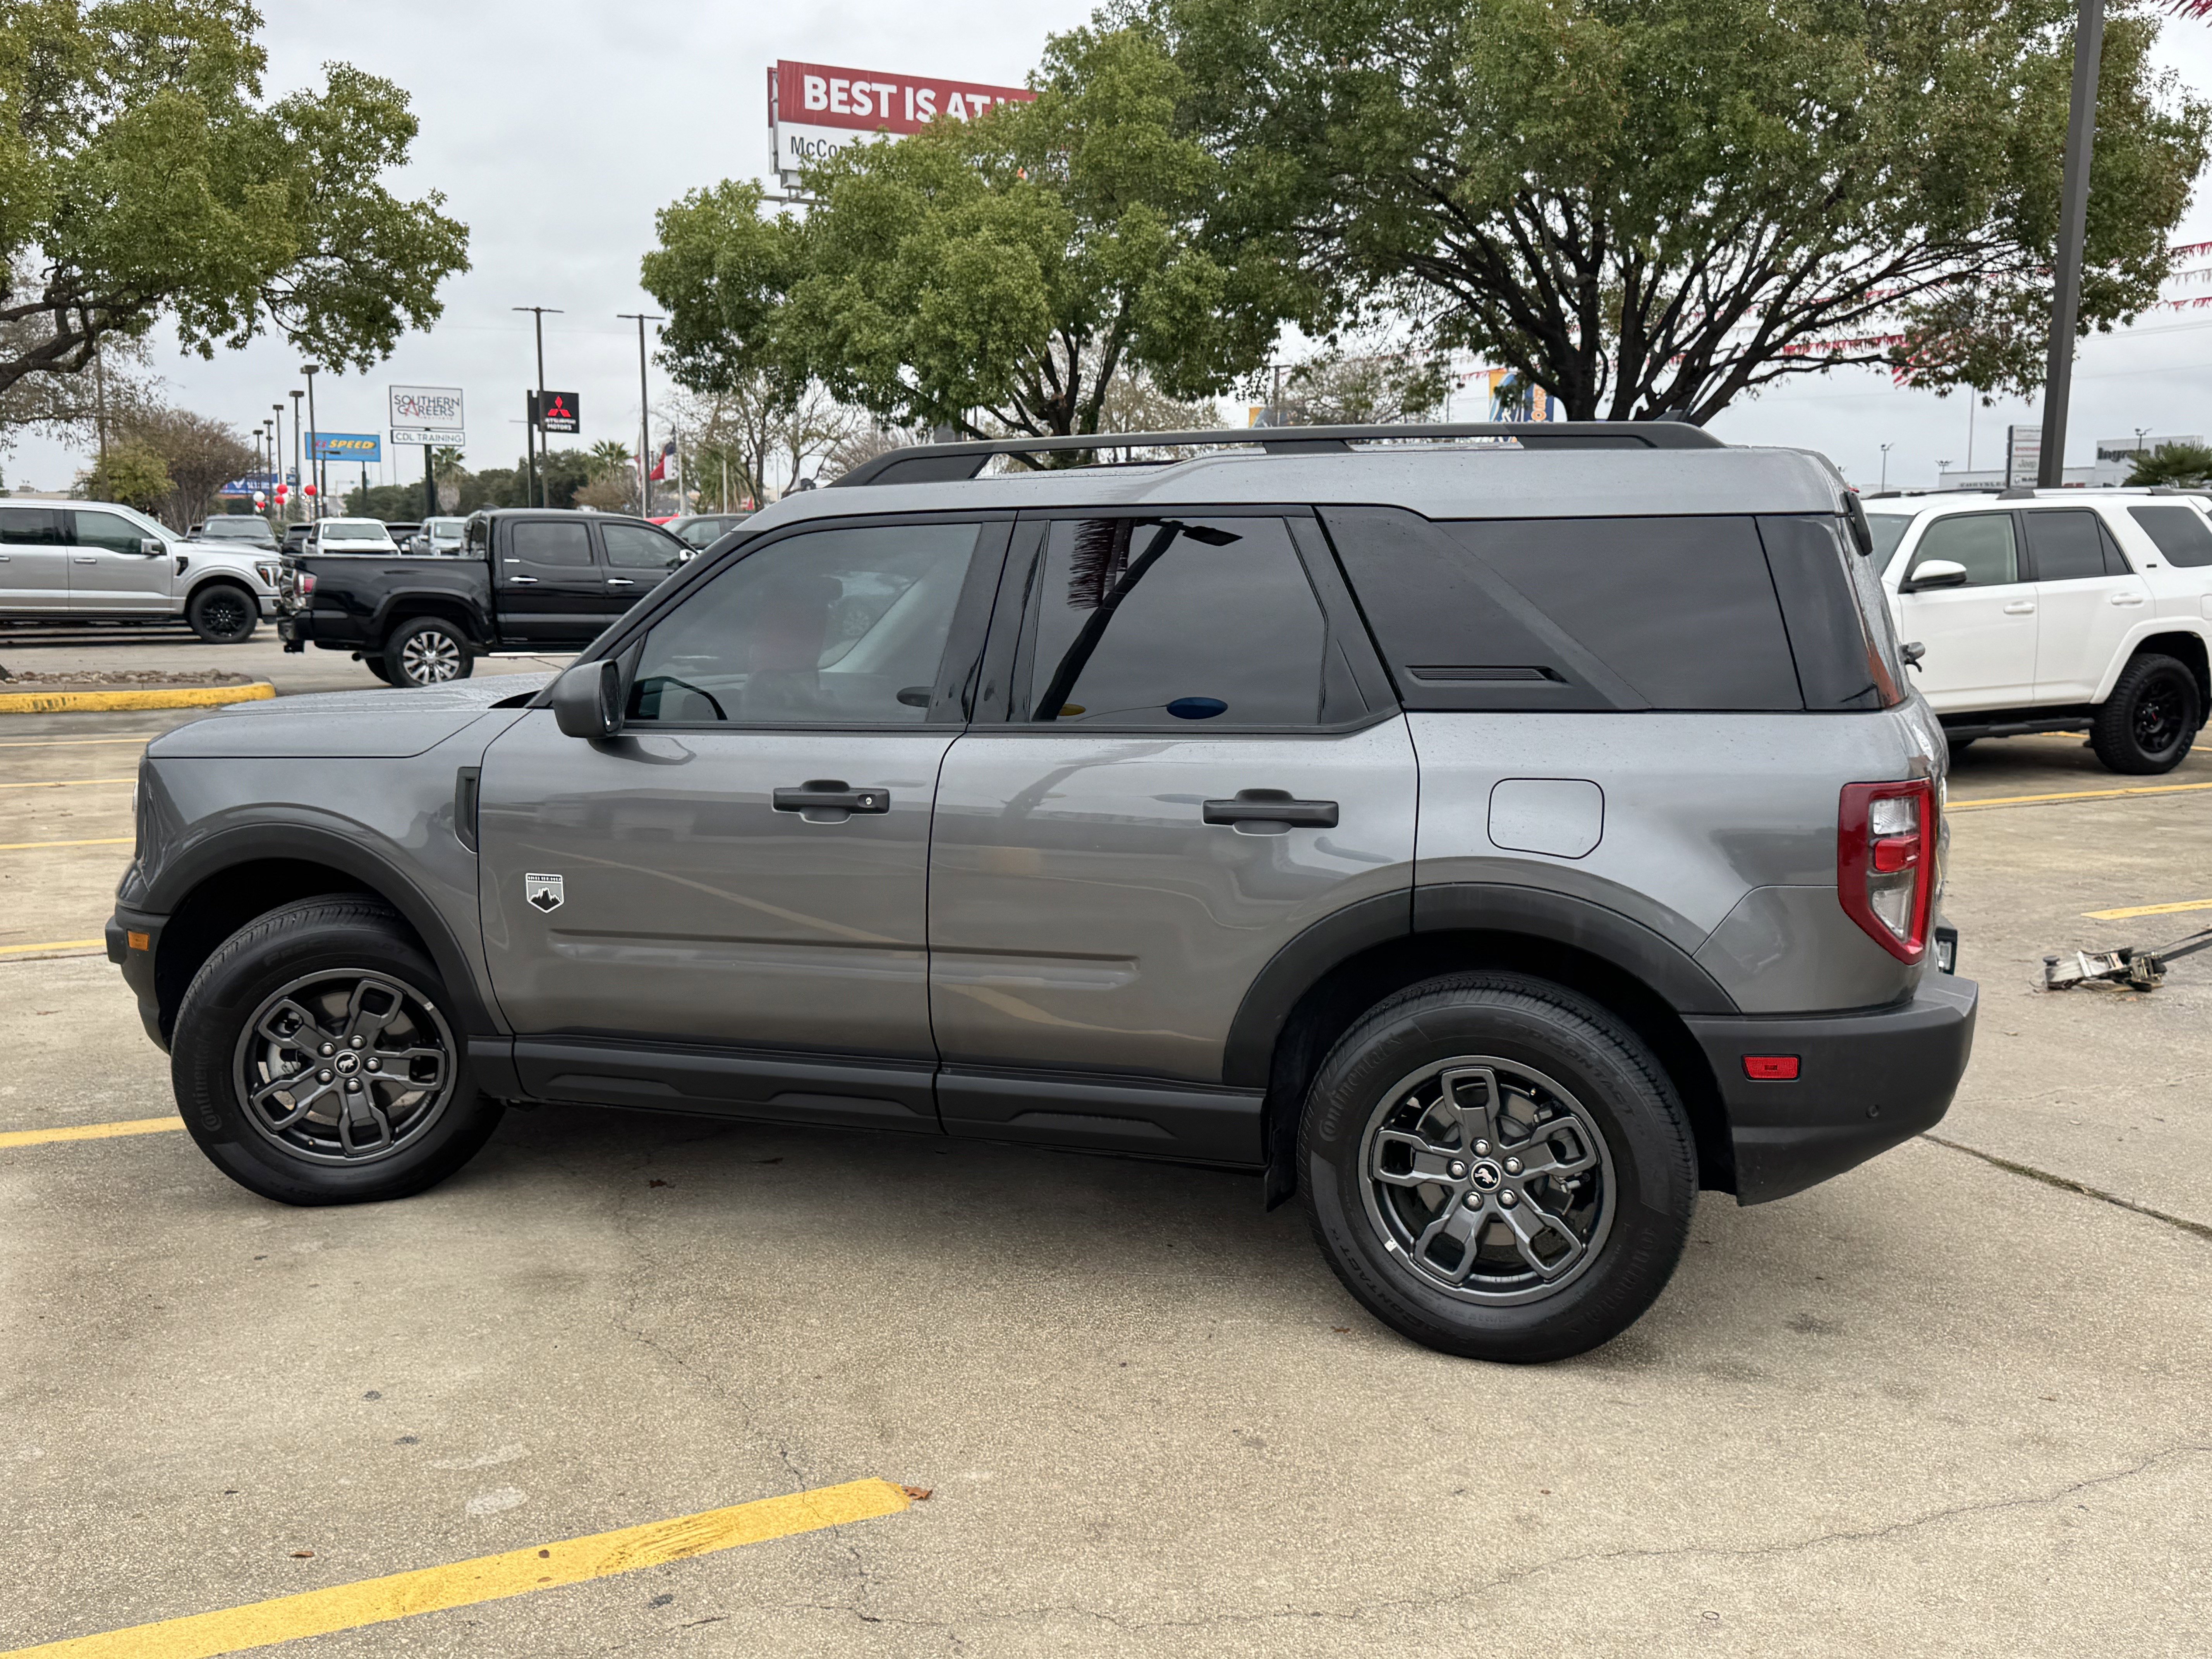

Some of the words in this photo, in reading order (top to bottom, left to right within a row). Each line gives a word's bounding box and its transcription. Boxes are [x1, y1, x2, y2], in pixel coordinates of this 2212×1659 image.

[804, 74, 897, 118] BEST
[905, 86, 937, 124] IS
[946, 92, 991, 124] AT
[791, 136, 840, 158] McCo
[394, 395, 460, 407] SOUTHERN
[397, 400, 455, 417] CAREERS
[330, 439, 376, 449] SPEED
[395, 432, 414, 441] CDL
[417, 433, 462, 443] TRAINING
